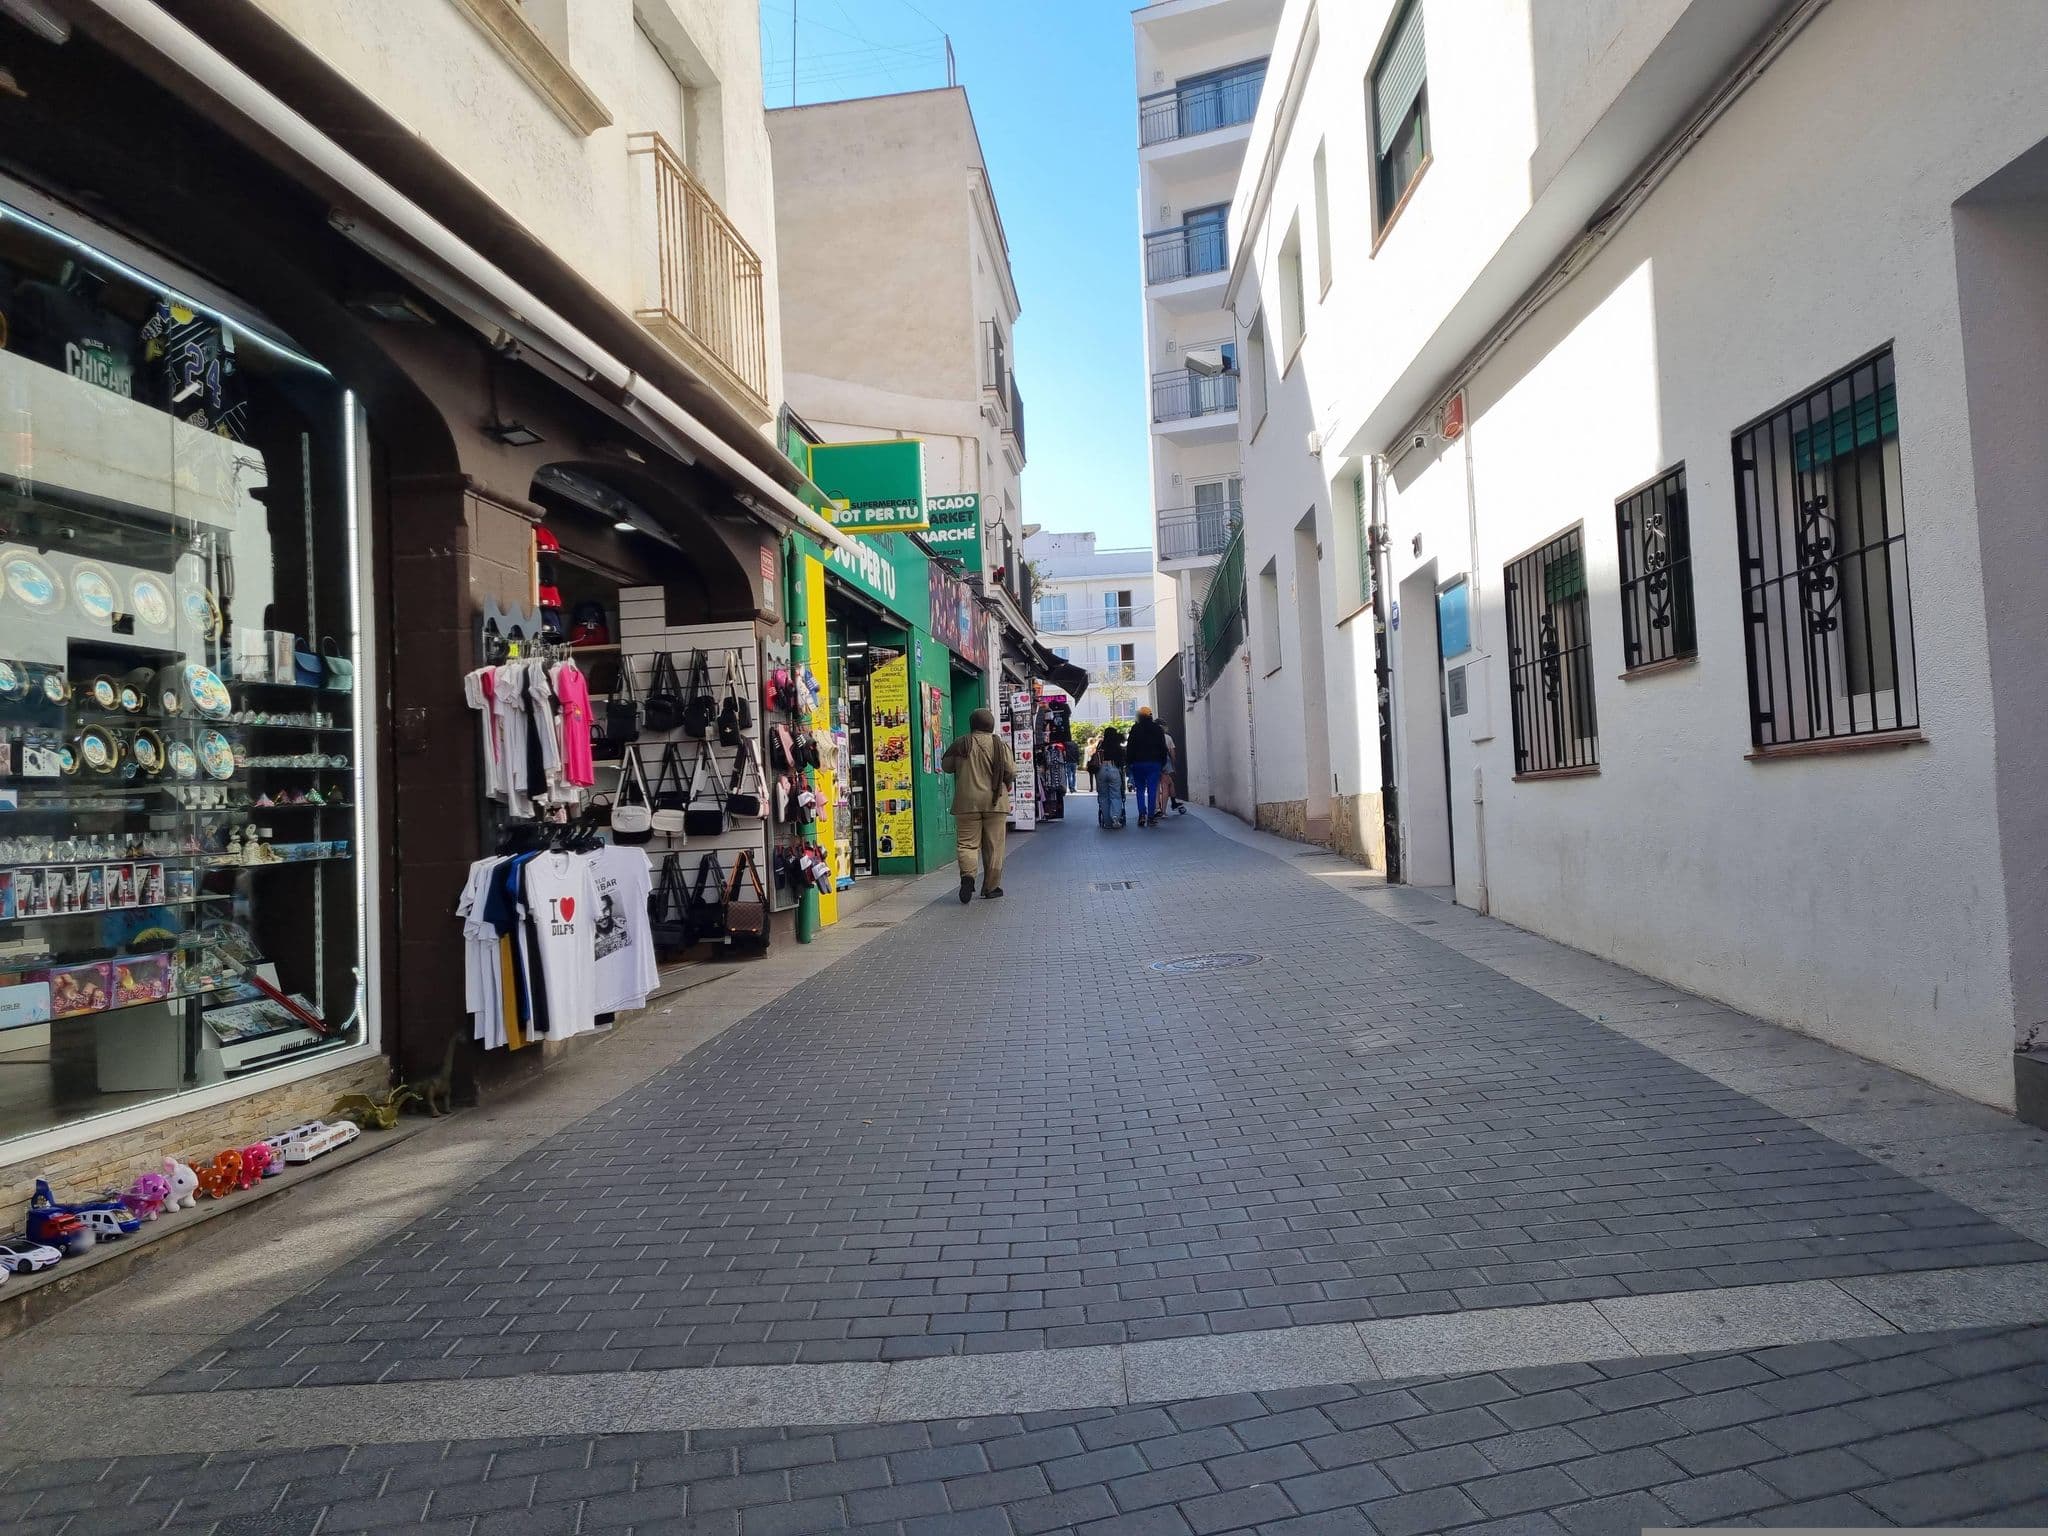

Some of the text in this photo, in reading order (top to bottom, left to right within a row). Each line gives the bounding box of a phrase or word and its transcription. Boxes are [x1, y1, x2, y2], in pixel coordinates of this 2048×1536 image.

[65, 341, 132, 399] CHICAG
[851, 498, 917, 510] SUPERMERCATS
[926, 496, 975, 511] RCADO
[865, 507, 895, 522] PER
[897, 506, 919, 520] TU
[928, 510, 974, 526] ARKET
[858, 541, 881, 591] PER
[880, 558, 896, 601] TU
[549, 899, 558, 923] I
